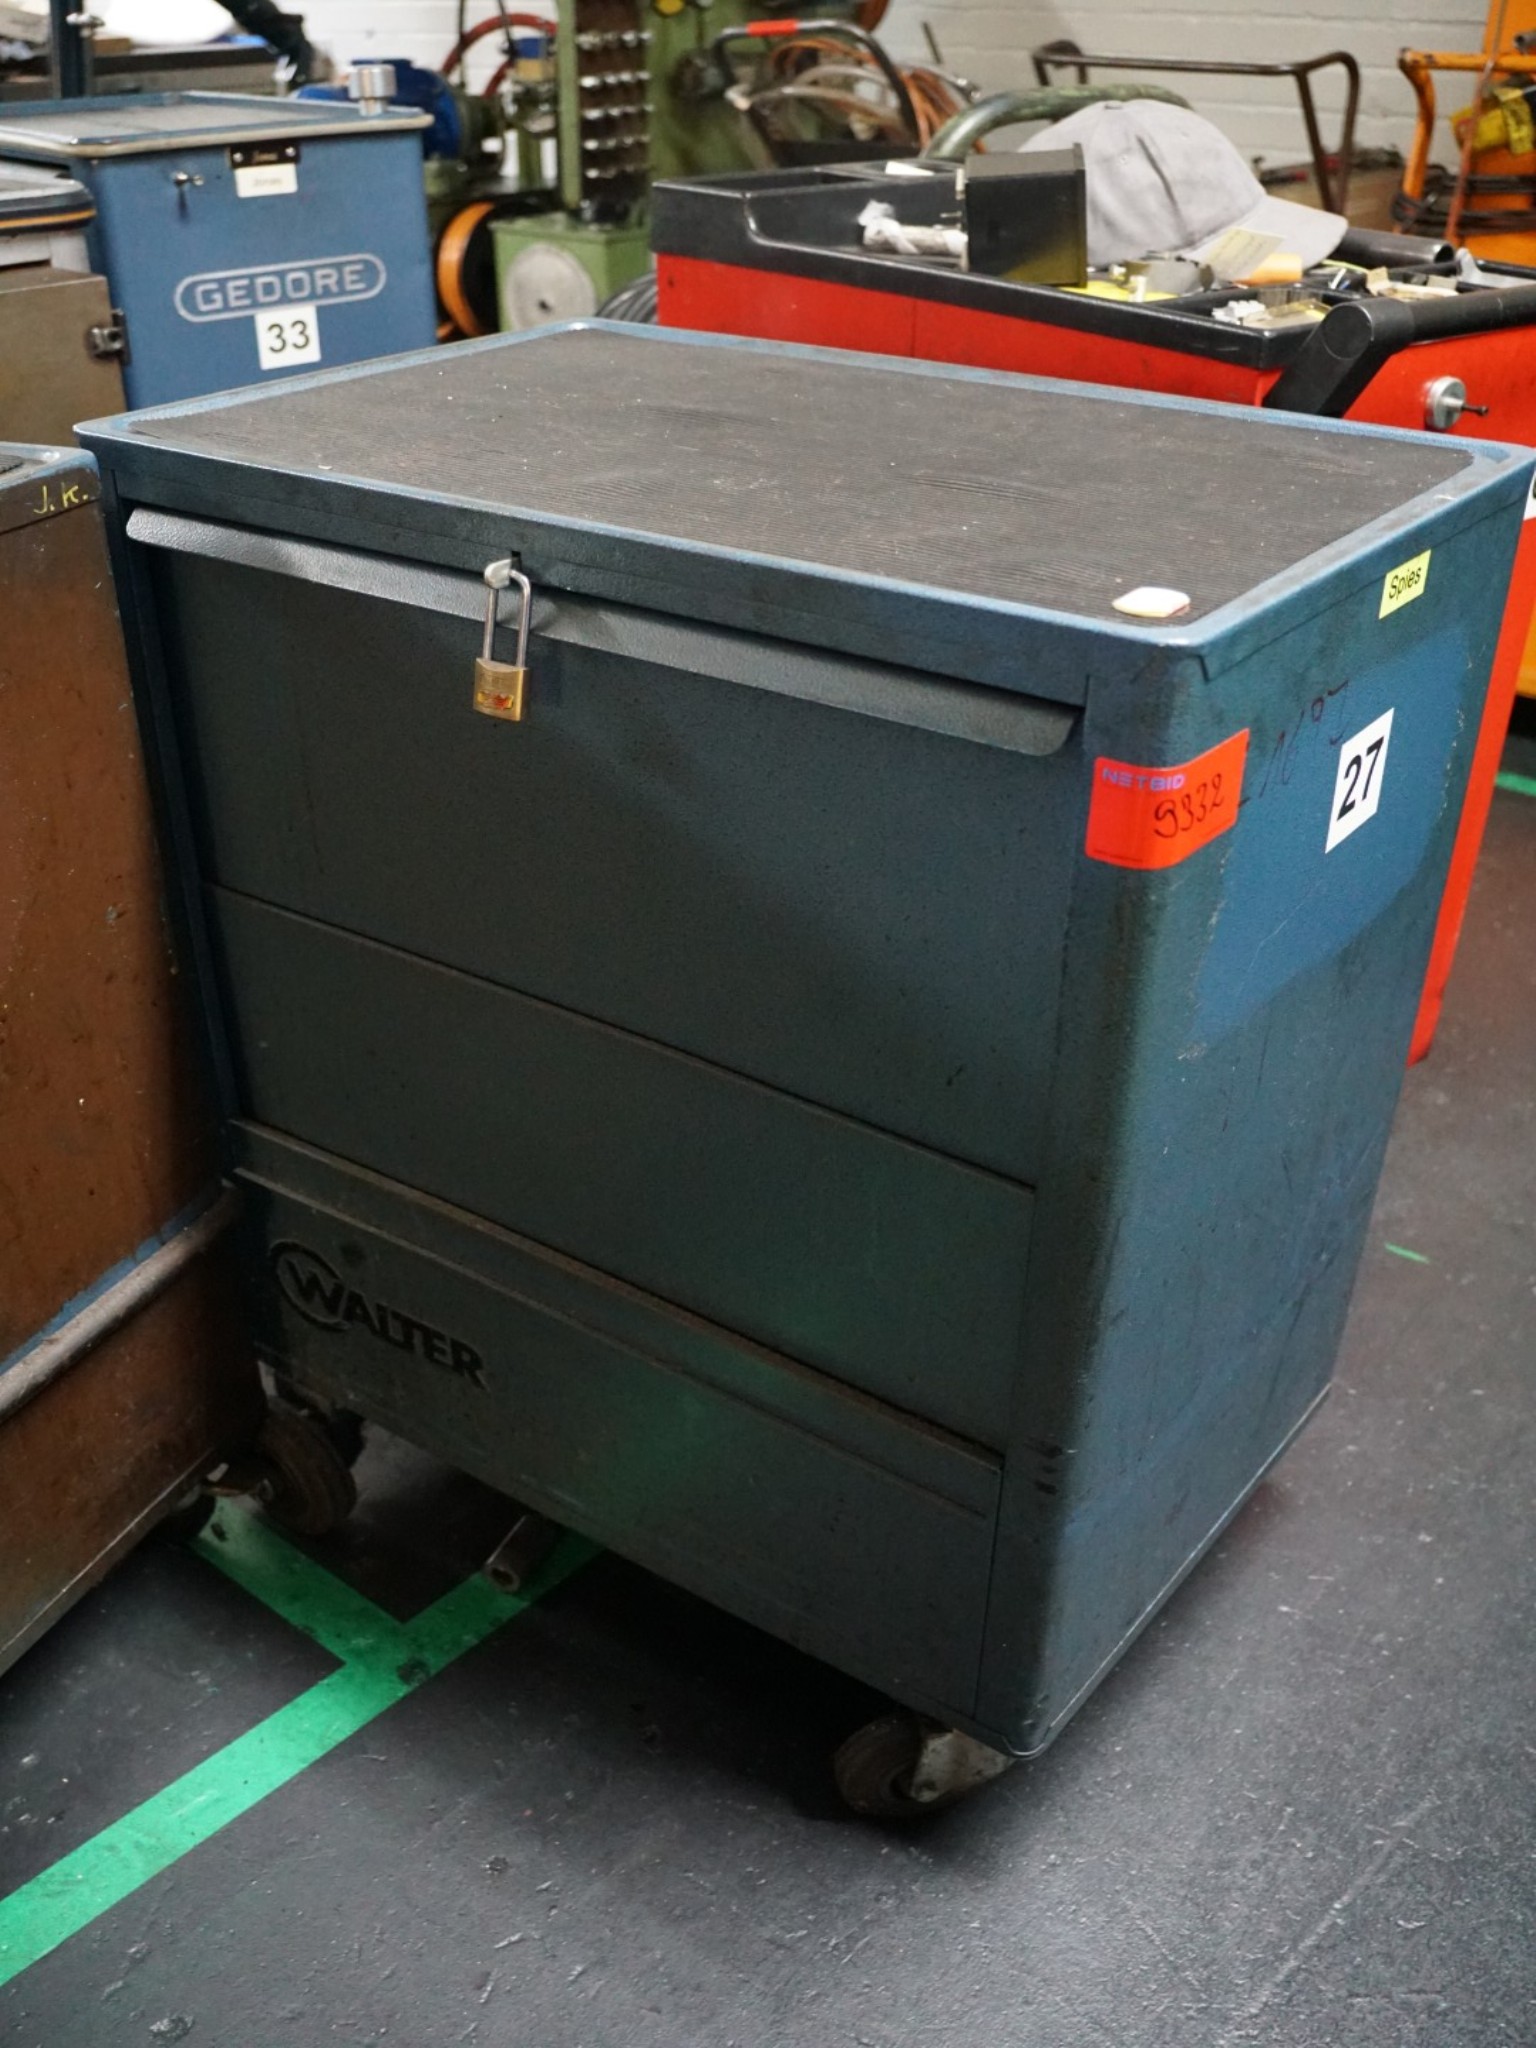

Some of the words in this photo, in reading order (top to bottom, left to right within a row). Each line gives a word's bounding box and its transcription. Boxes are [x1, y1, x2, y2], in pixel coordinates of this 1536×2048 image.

[195, 263, 367, 312] GEDORE
[267, 320, 310, 353] 33
[1388, 567, 1421, 601] Spies
[1102, 767, 1187, 792] NETBID
[1337, 736, 1385, 821] 27
[282, 1255, 489, 1391] WALTER
